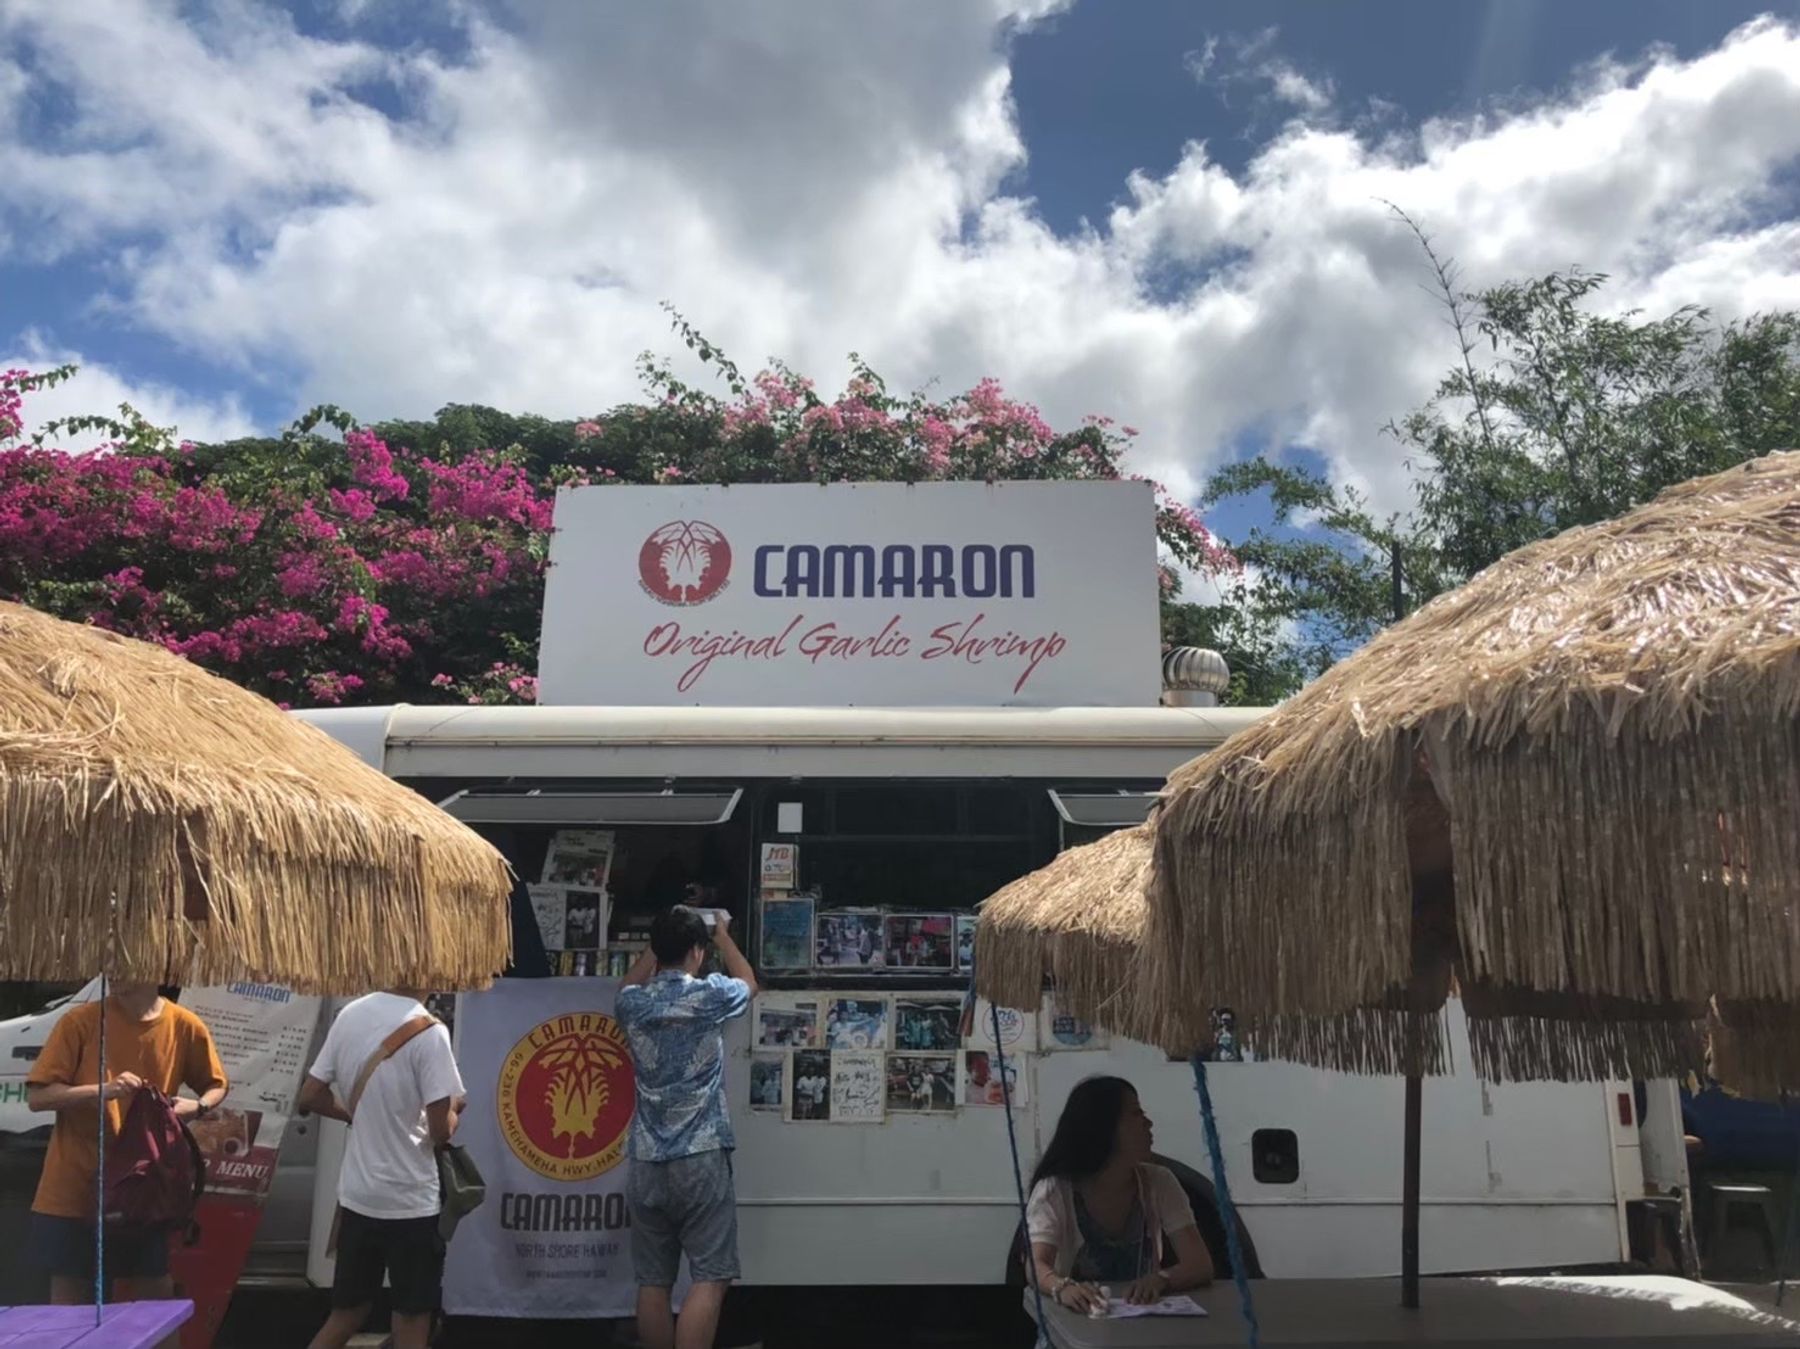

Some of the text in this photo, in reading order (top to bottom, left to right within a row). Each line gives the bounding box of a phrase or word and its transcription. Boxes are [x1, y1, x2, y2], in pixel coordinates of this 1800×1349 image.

[754, 544, 1035, 598] CAMARON
[643, 613, 1067, 695] Original Garlic Shrimp
[528, 1014, 628, 1049] CAMARO
[216, 1160, 269, 1180] MENU
